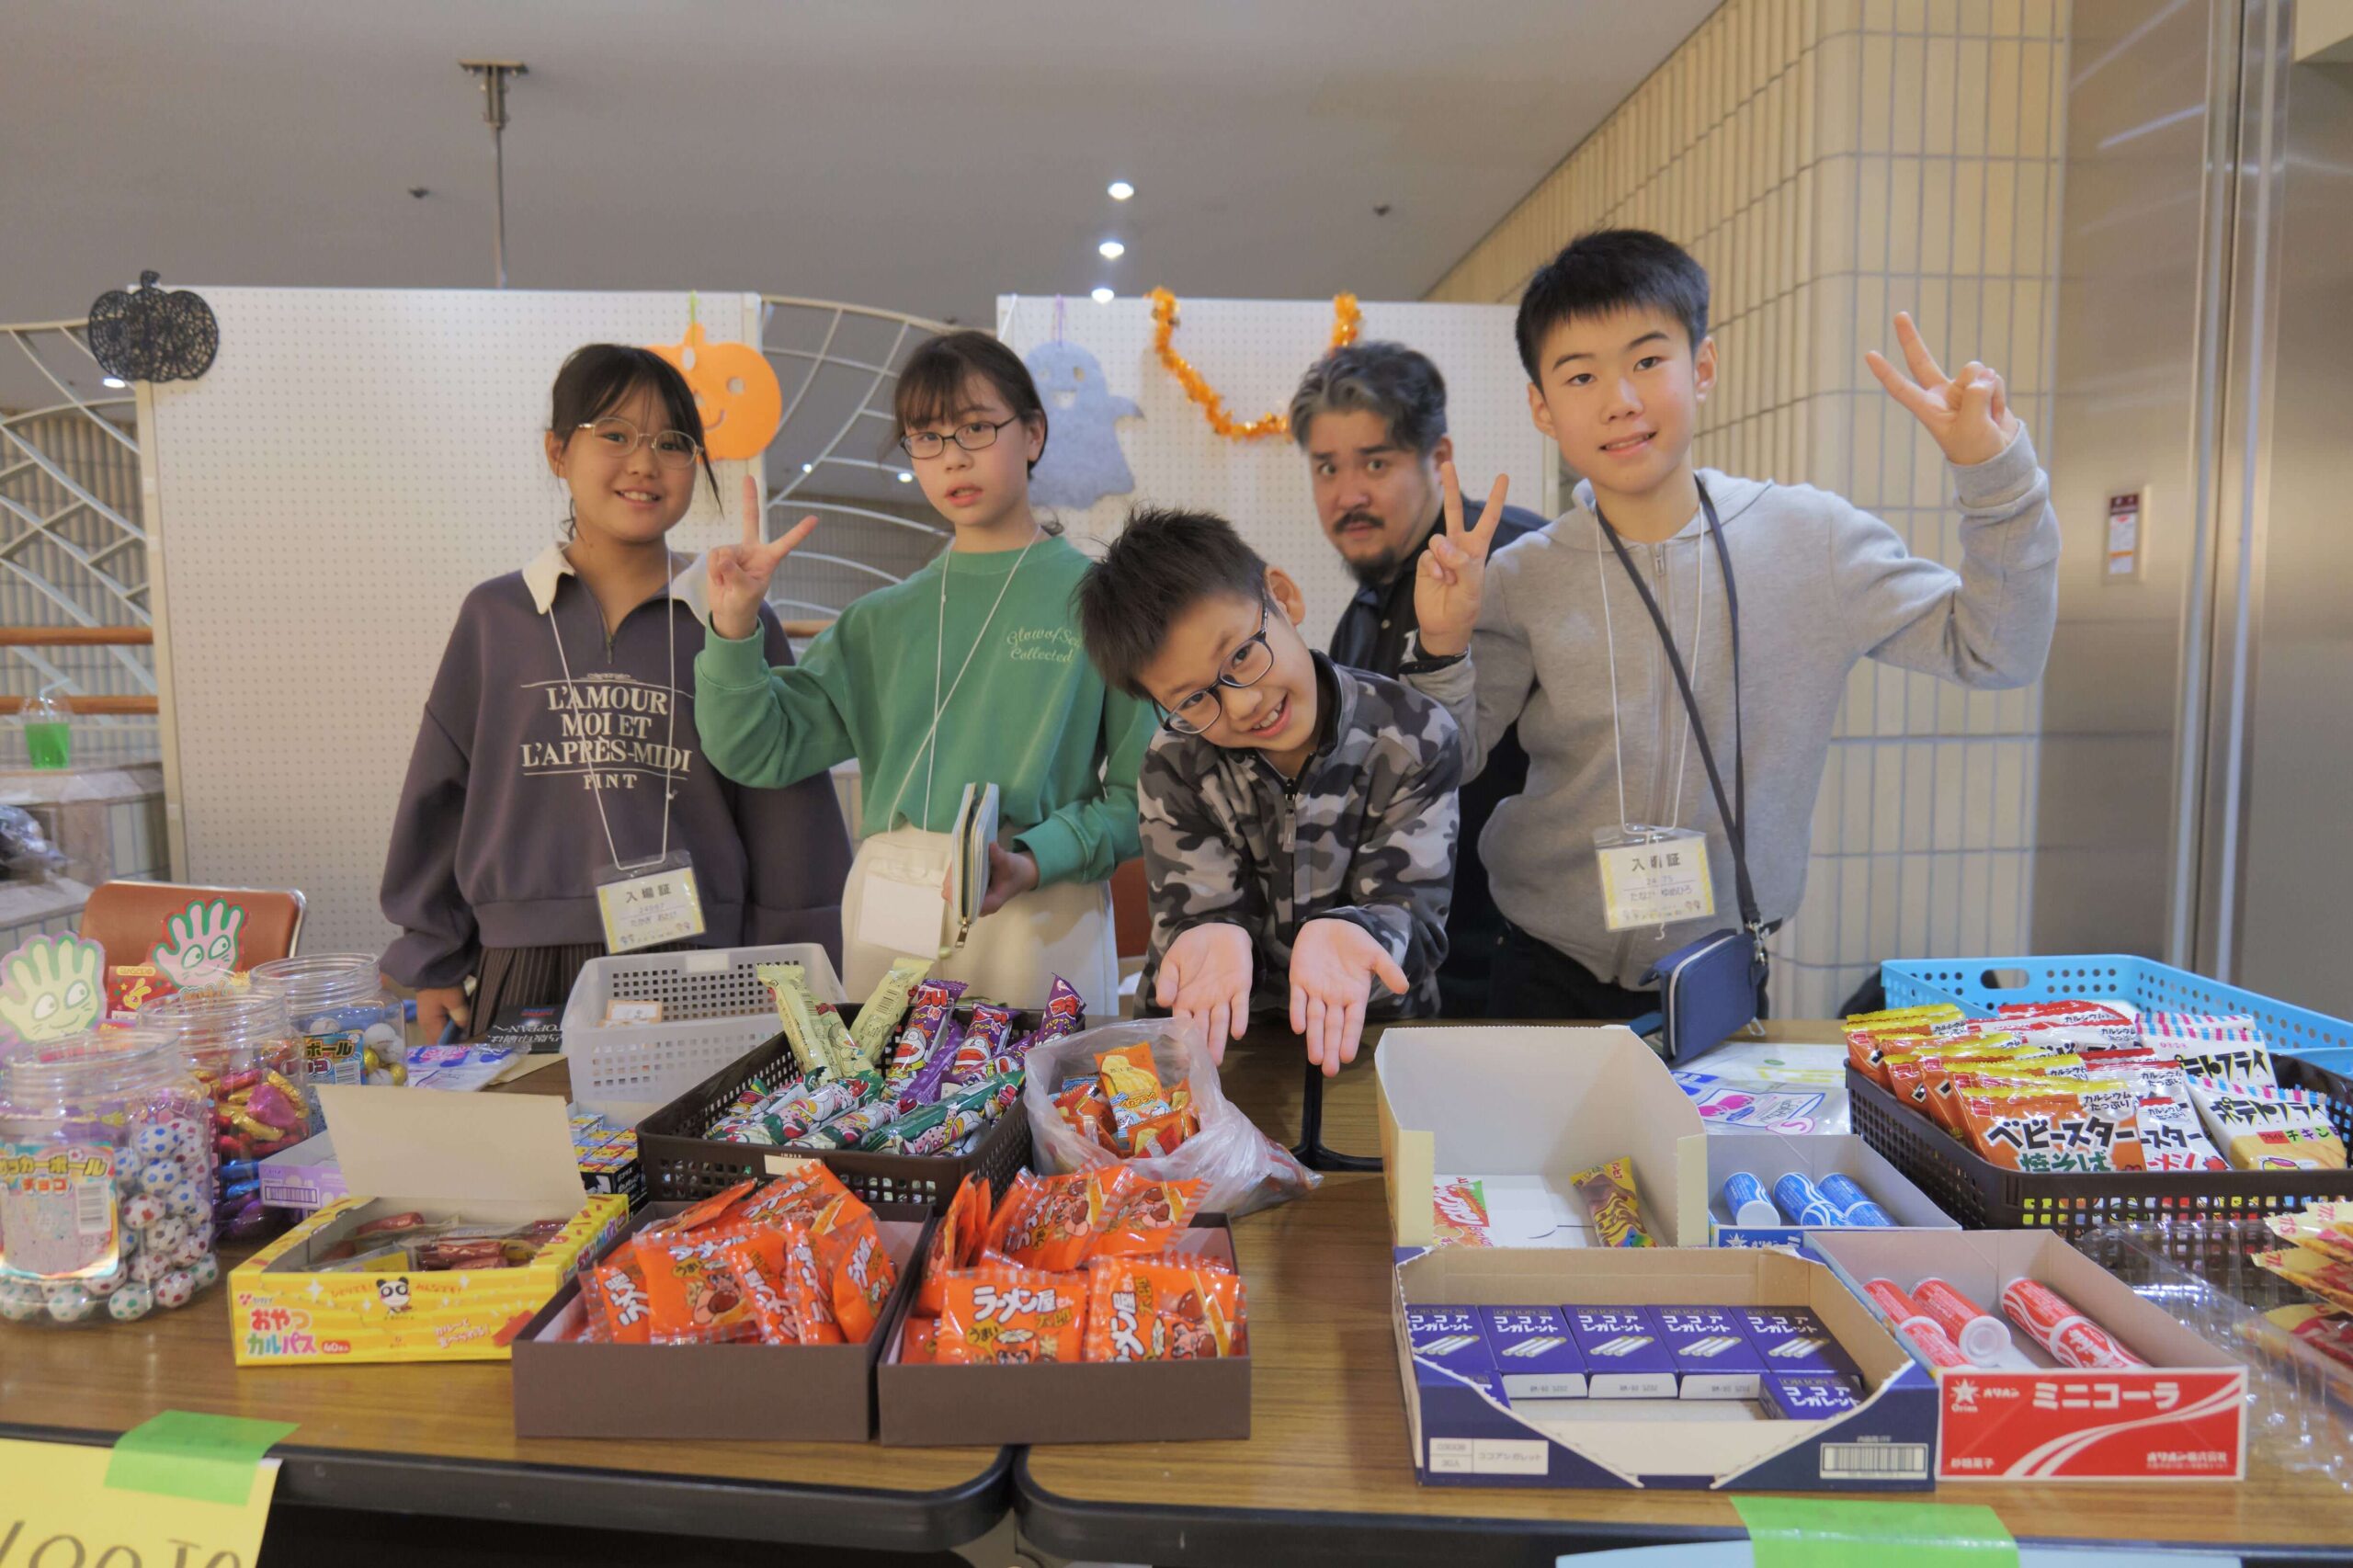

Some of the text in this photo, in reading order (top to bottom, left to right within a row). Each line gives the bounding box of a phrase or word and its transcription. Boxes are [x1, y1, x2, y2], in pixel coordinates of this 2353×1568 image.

[546, 686, 668, 715] L'AMOUR
[560, 712, 652, 738] MOI ET
[520, 735, 693, 772] L'APRÈS-MIDI
[625, 883, 671, 903] 入場証
[2174, 1049, 2270, 1082] テトフライ
[2084, 1091, 2132, 1104] カルシウム
[2090, 1101, 2130, 1112] たっぷり
[2209, 1096, 2326, 1126] ポテトフライ
[1987, 1116, 2135, 1150] ベビースター
[2019, 1150, 2111, 1172] 焼そば
[21, 1176, 68, 1192] チョコ
[972, 1286, 1056, 1324] ラーメン屋
[250, 1308, 310, 1332] おやつ
[1109, 1291, 1145, 1362] ーメン屋
[246, 1332, 317, 1355] カルパス
[969, 1325, 1000, 1343] うまい
[1781, 1386, 1851, 1397] ココア
[2032, 1381, 2180, 1410] ミニコーラ
